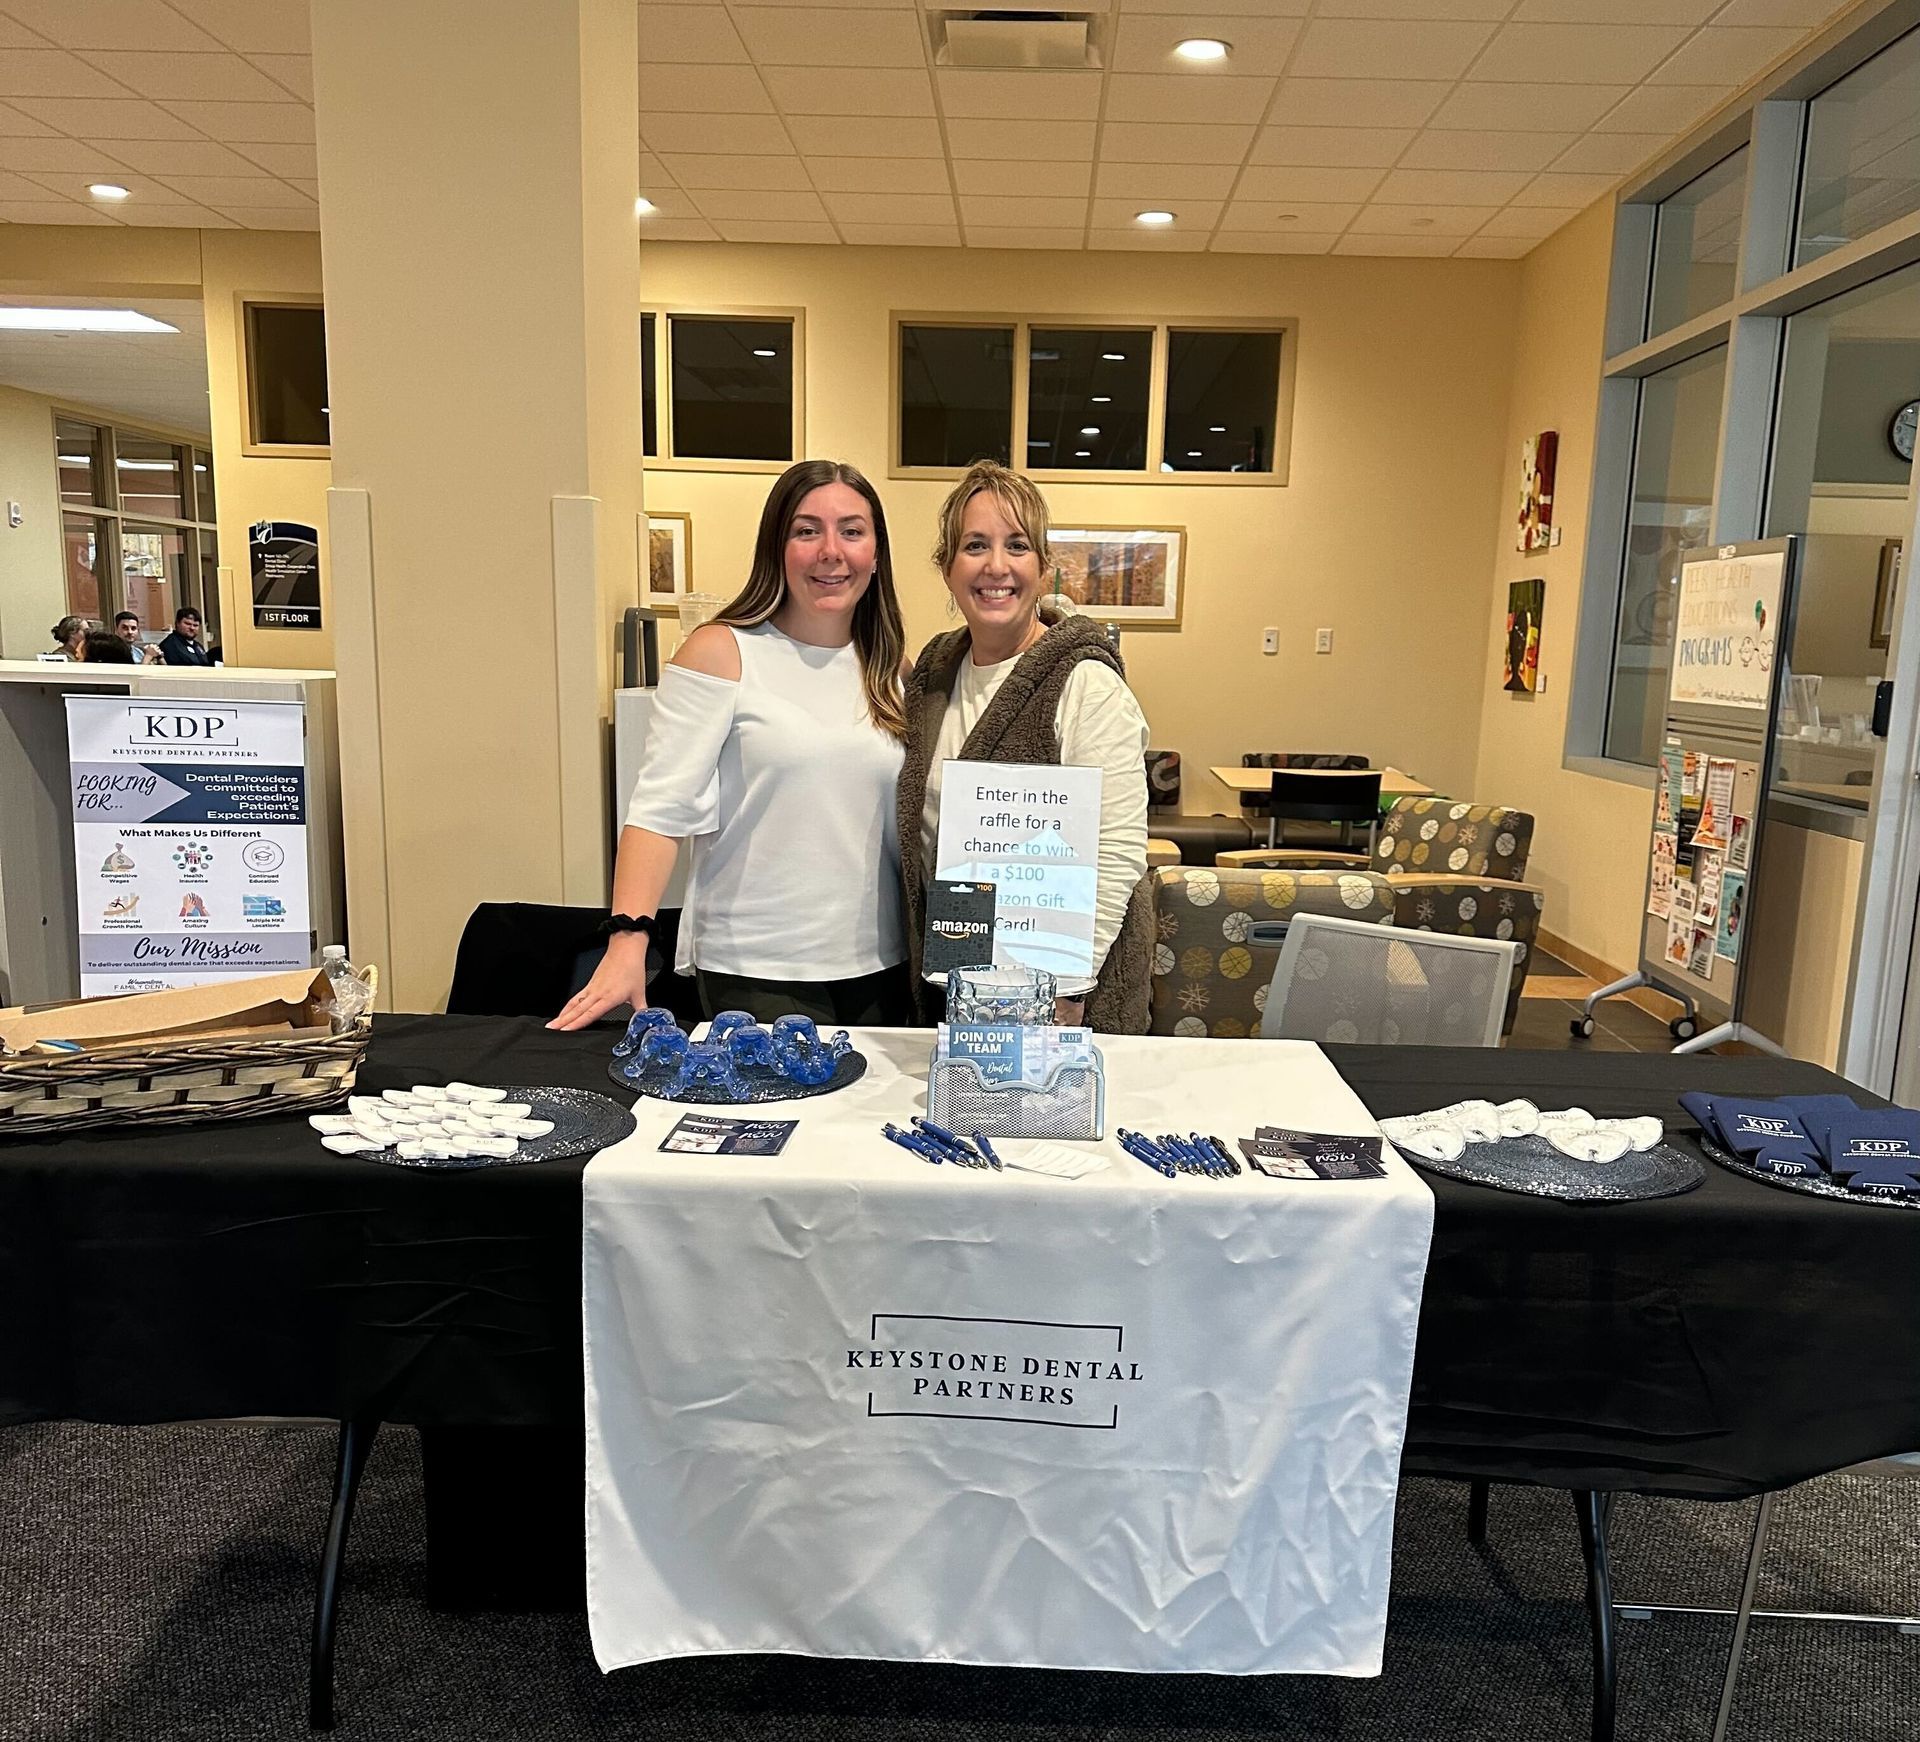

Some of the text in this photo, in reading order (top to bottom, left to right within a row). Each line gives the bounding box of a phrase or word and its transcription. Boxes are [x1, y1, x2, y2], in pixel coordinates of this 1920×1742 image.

[264, 613, 309, 622] 1ST FLOOR
[1680, 636, 1734, 667] PROGRAMS
[144, 716, 225, 739] KDP
[186, 773, 298, 783] Dental Providers
[77, 774, 158, 796] LOOKING
[204, 784, 278, 793] committed
[230, 794, 299, 803] exceeding
[976, 786, 1068, 805] Enter in the
[239, 802, 300, 811] Patient's
[207, 811, 300, 820] Expectations.
[980, 813, 1061, 830] raffle for a
[119, 829, 152, 837] What
[154, 829, 191, 837] Makes
[210, 830, 262, 838] Different
[964, 837, 1074, 857] chance to win
[991, 865, 1045, 882] a $100
[998, 893, 1065, 908] azon Gift
[932, 920, 988, 934] amazon
[994, 916, 1036, 932] Card!
[134, 936, 262, 960] Our Mission
[954, 1031, 1014, 1044] JOIN OUR
[1060, 1034, 1081, 1042] KDP
[967, 1042, 1002, 1054] TEAM
[987, 1062, 1014, 1074] Dental
[1746, 1118, 1784, 1131] KDP
[1858, 1142, 1902, 1152] KDP
[1773, 1163, 1803, 1175] KDP
[846, 1350, 1144, 1381] KEYSTONE DENTAL
[913, 1378, 1074, 1405] PARTNERS
